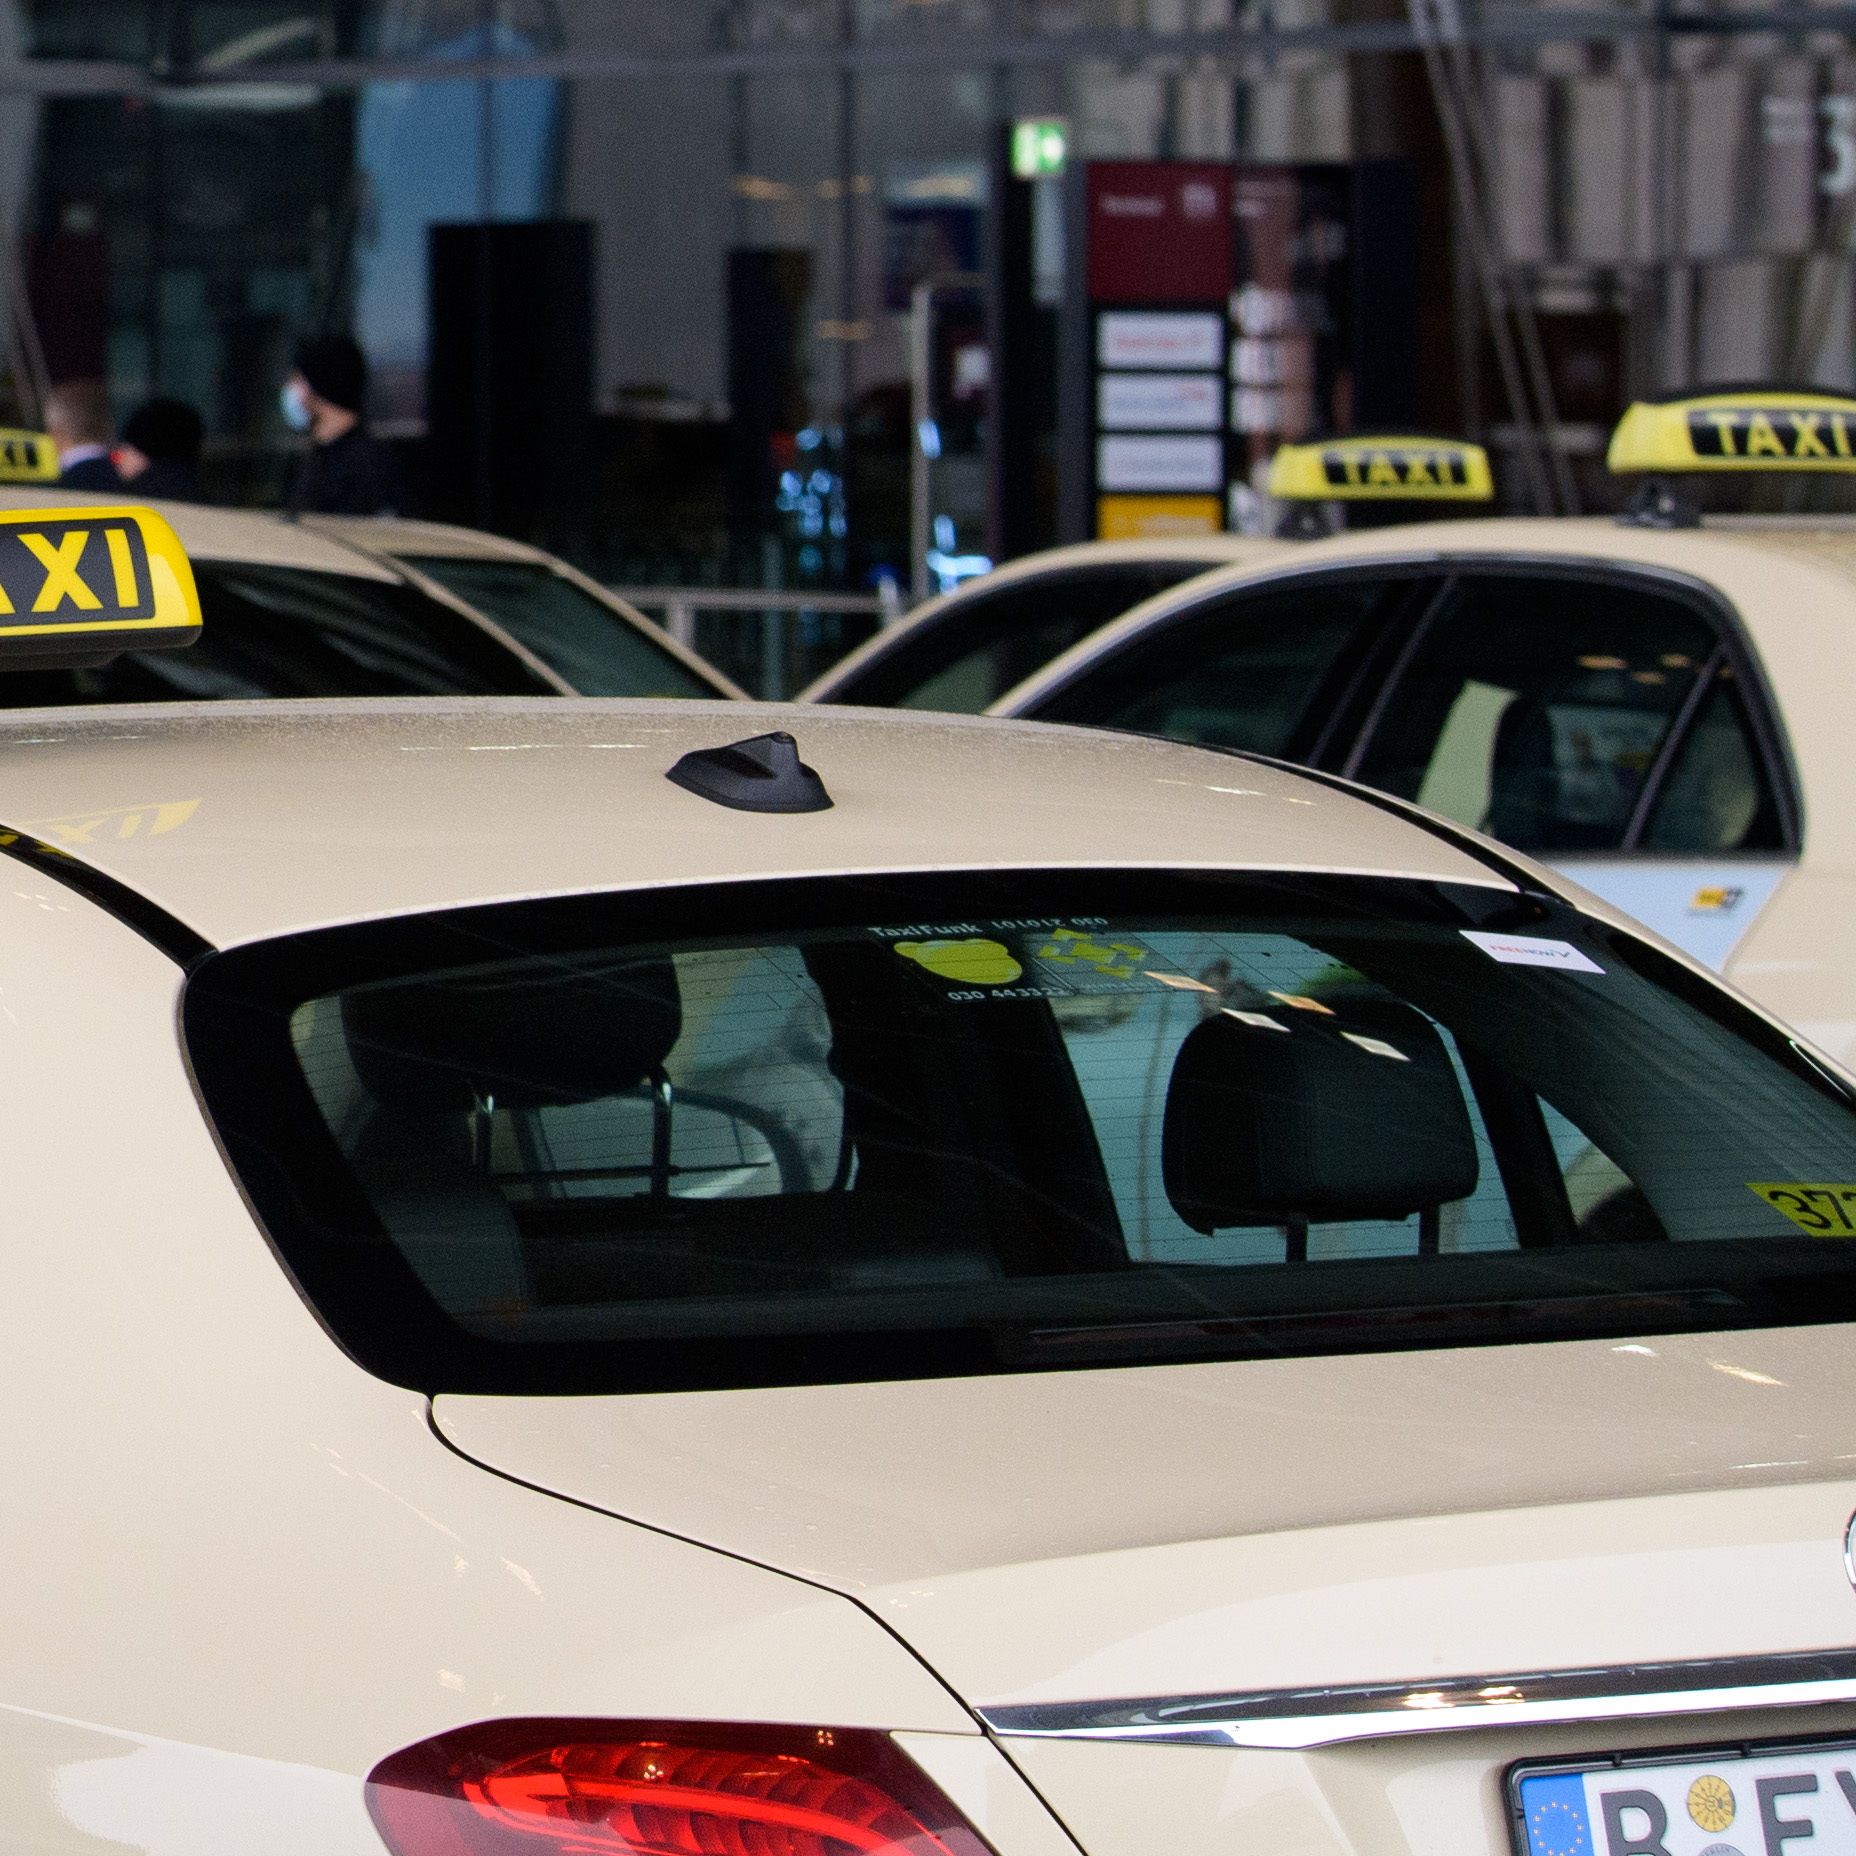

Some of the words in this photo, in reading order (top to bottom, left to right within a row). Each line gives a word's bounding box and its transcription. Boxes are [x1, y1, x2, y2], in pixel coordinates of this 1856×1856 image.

[1704, 413, 1855, 457] TAXI
[1335, 451, 1458, 486] TAXI
[867, 923, 984, 938] TaxiFunk
[947, 989, 986, 1001] 030
[1600, 1789, 1671, 1856] B
